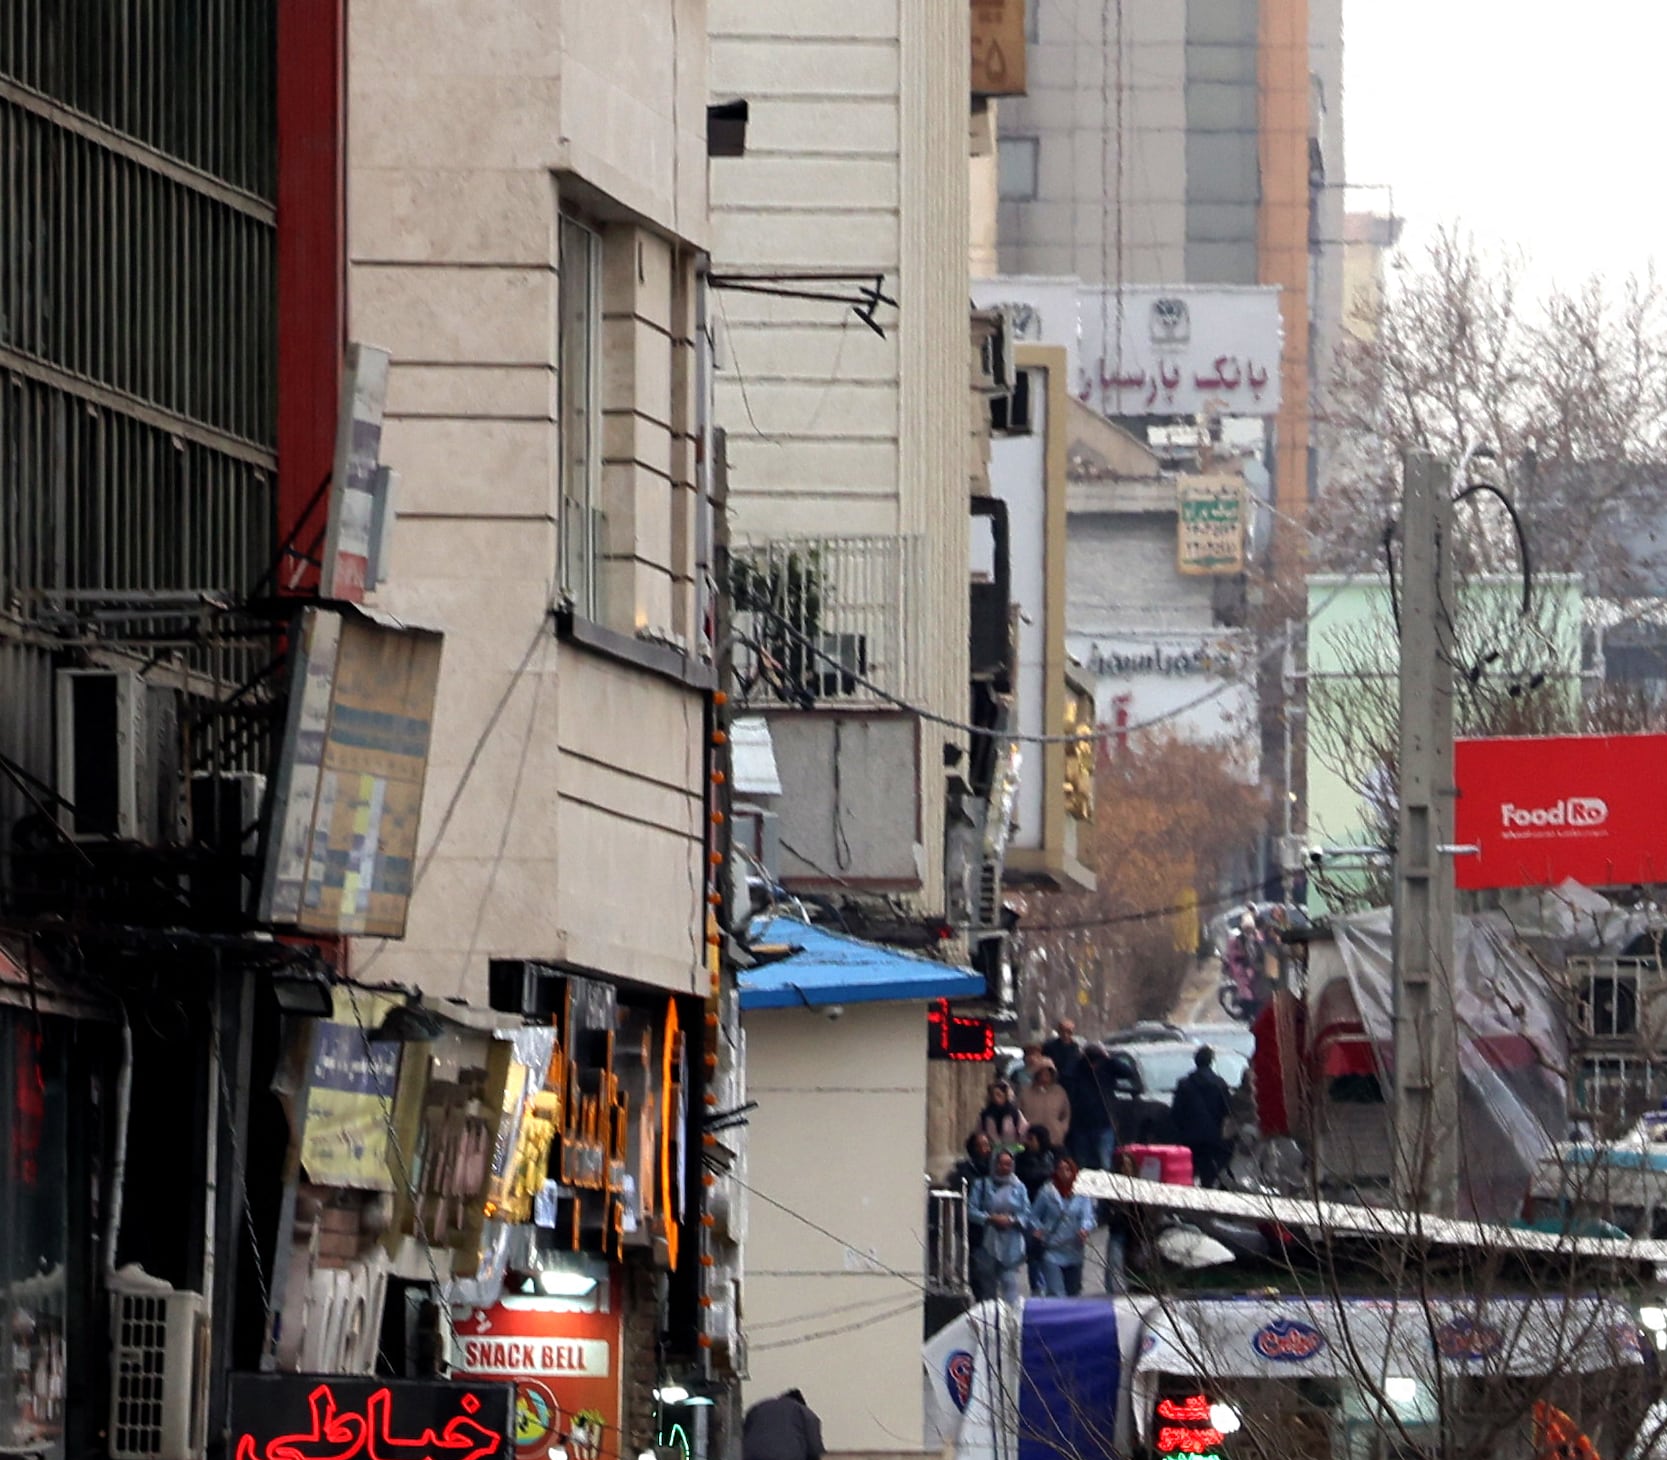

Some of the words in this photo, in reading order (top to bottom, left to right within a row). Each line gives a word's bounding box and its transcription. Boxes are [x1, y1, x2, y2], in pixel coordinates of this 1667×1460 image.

[1196, 354, 1268, 402] بانک
[465, 1341, 535, 1370] SNACK
[541, 1344, 588, 1371] BELL
